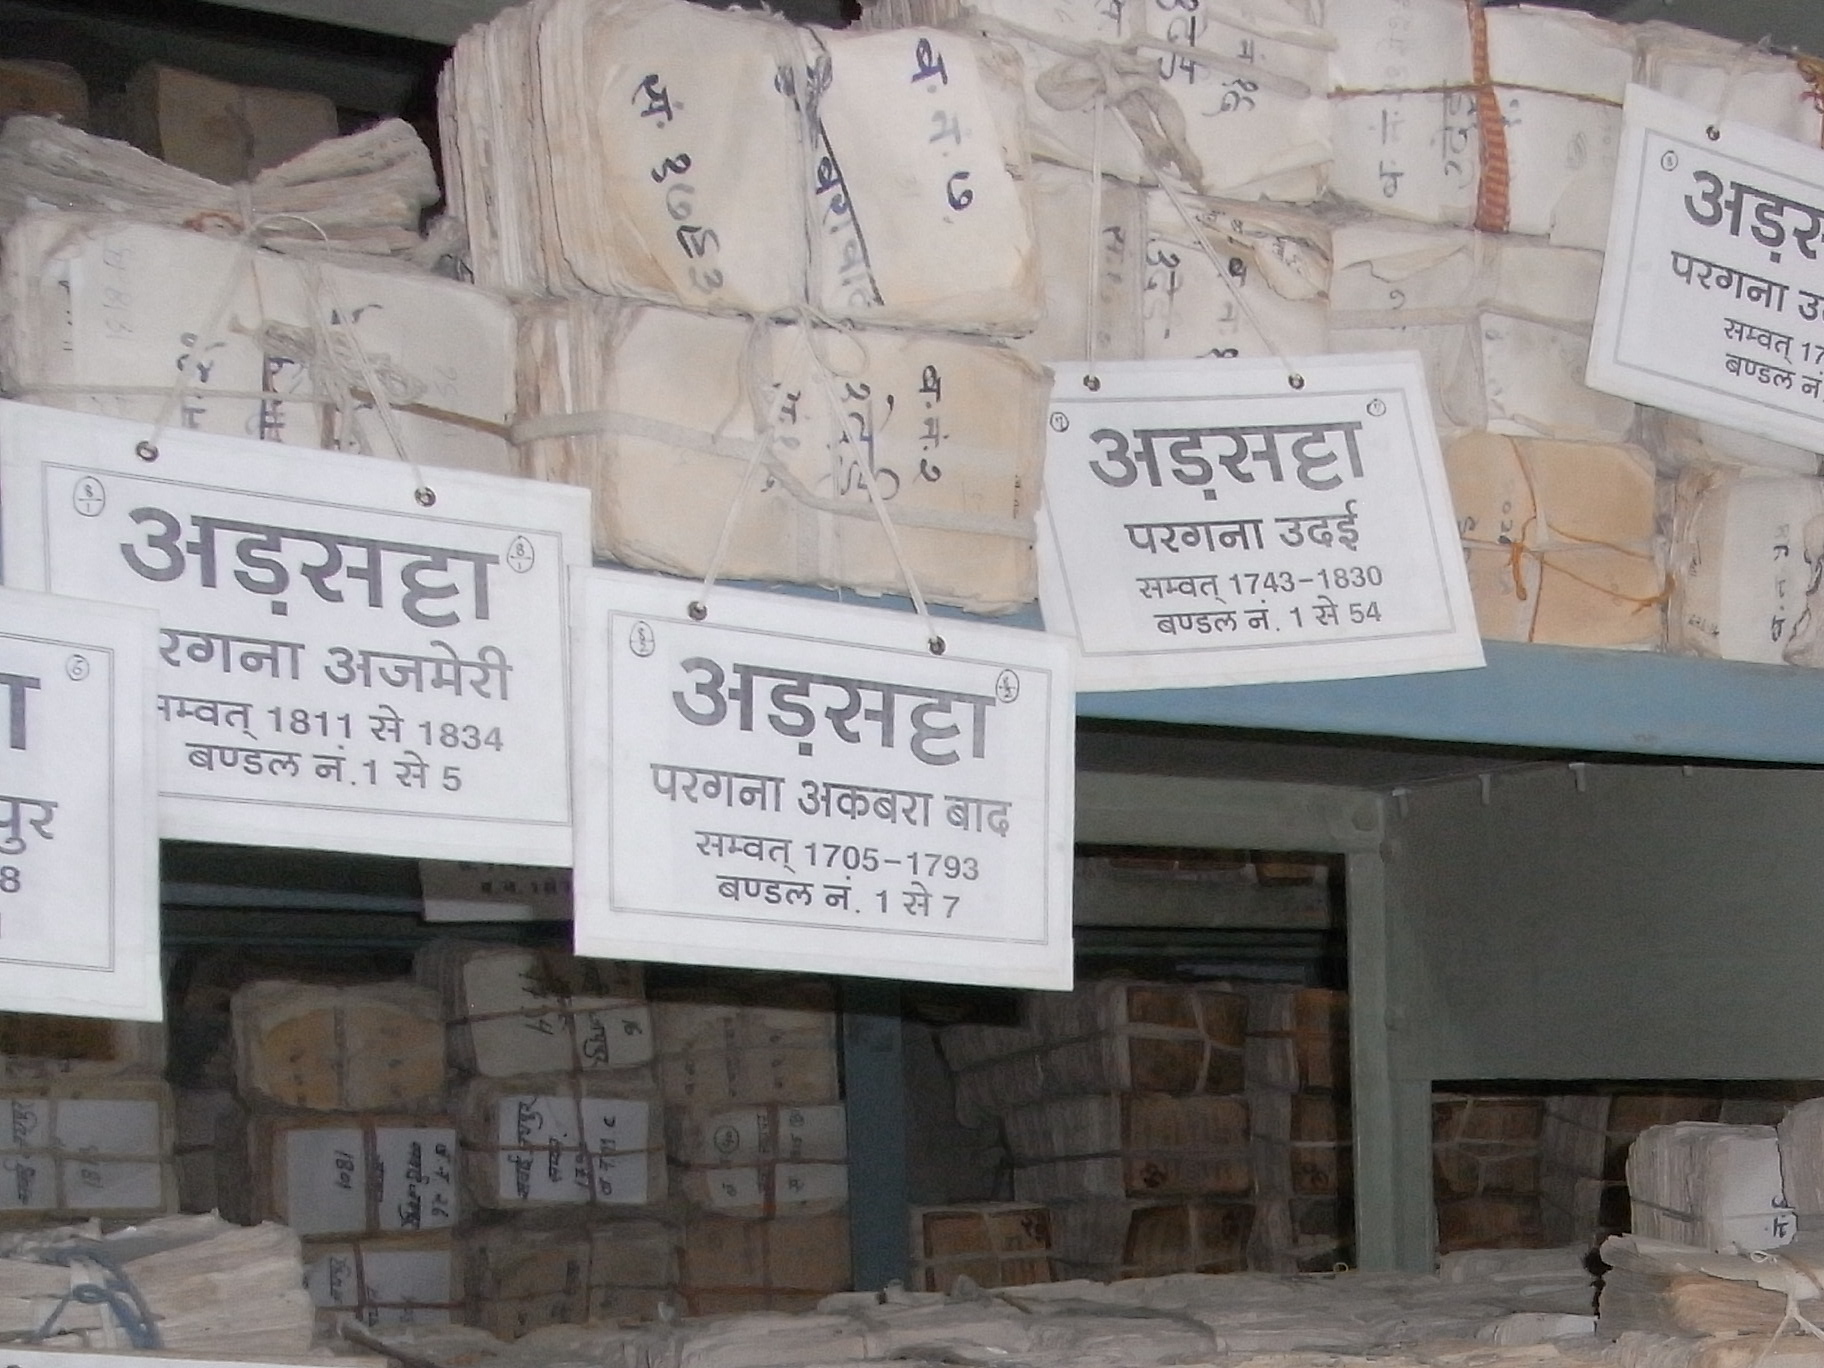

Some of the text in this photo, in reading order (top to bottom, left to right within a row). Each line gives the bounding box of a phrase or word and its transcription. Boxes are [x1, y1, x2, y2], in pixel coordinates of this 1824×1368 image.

[1671, 250, 1789, 312] परगना
[1724, 318, 1793, 365] सम्वत्
[1725, 353, 1794, 390] बण्डल
[1089, 421, 1364, 501] अड़सट्टा
[1124, 500, 1359, 554] परगना उदई
[120, 507, 499, 628] अड़सट्टा
[1136, 574, 1226, 605] सम्वत्
[160, 628, 512, 700] रगना अजमेरी
[268, 708, 350, 738] 1811
[369, 705, 403, 743] से
[422, 720, 503, 753] 1834
[673, 657, 996, 765] अड़सट्टा
[651, 763, 1012, 837] परगना अकबरा बाद
[695, 830, 795, 873] सम्वत्
